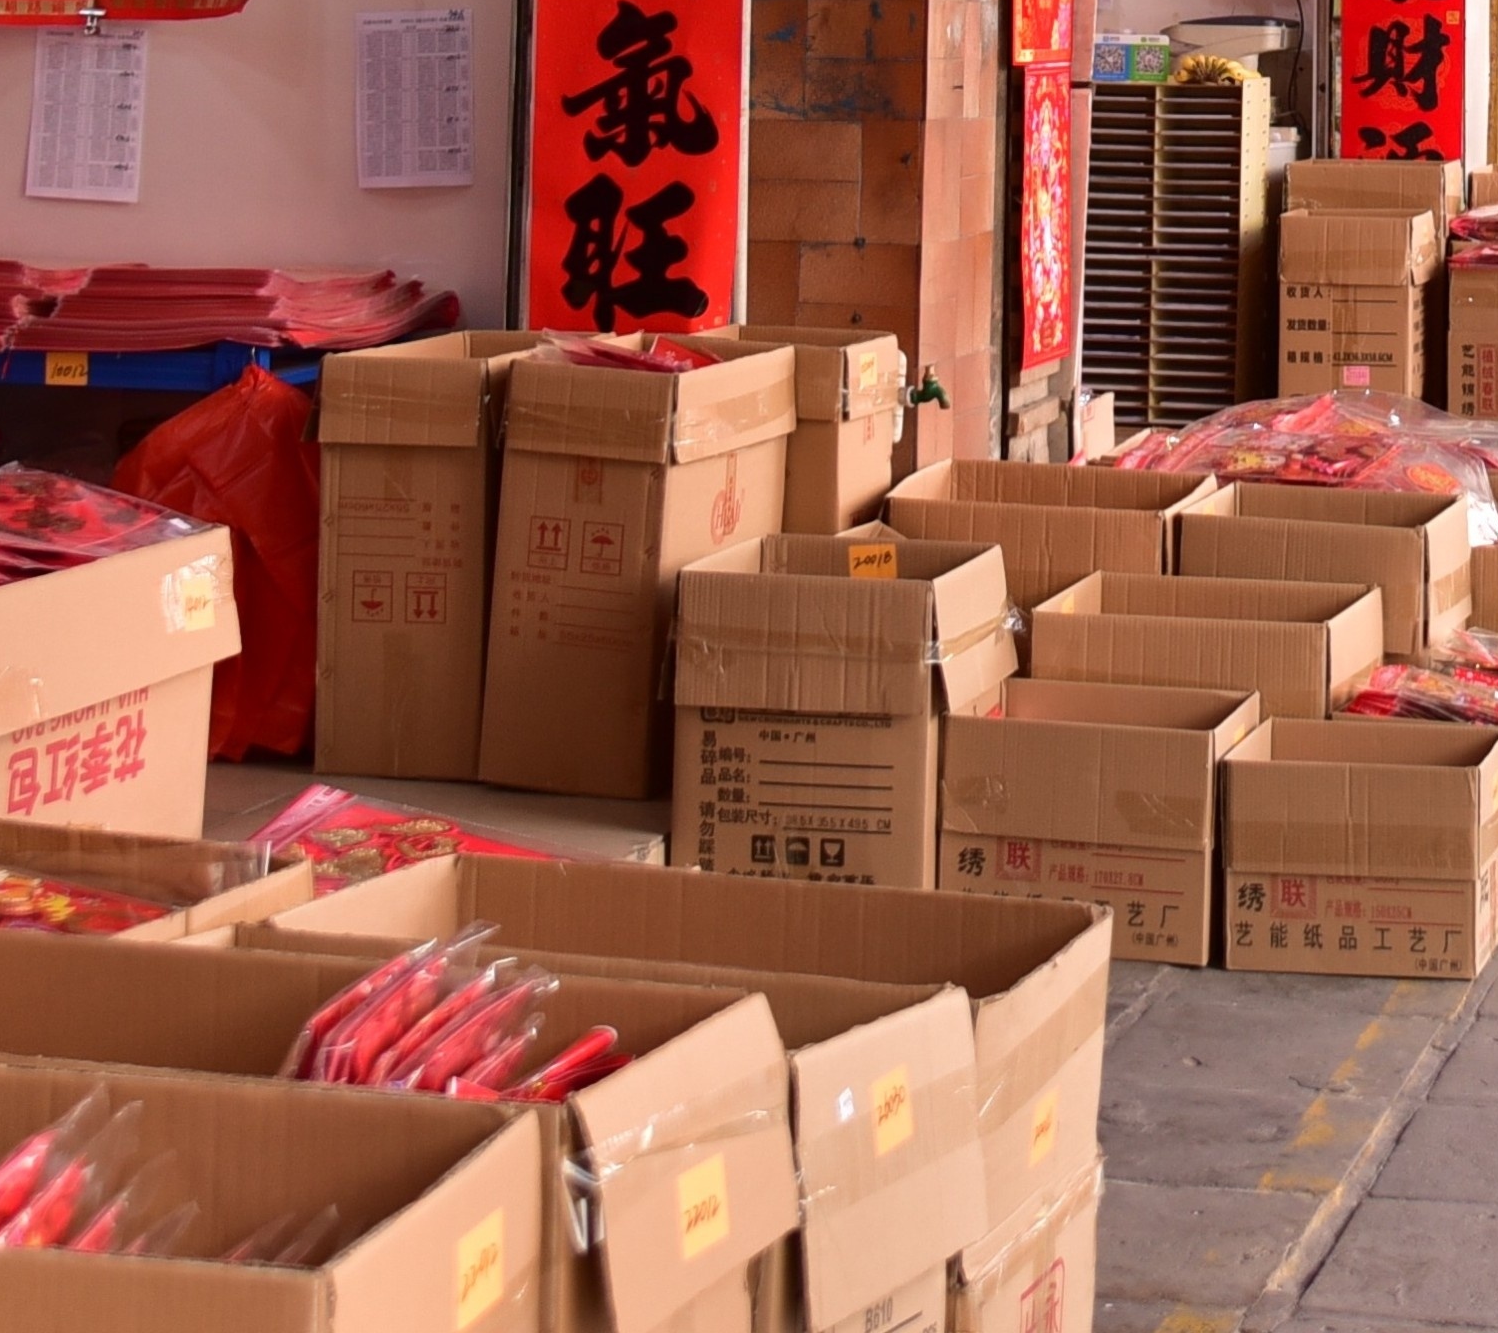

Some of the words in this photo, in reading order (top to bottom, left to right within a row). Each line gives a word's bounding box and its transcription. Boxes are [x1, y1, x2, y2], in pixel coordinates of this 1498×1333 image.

[3, 728, 147, 816] 花季红包
[958, 846, 986, 877] 绣
[1005, 841, 1032, 871] 联
[1238, 883, 1266, 912] 绣
[1281, 879, 1306, 908] 联
